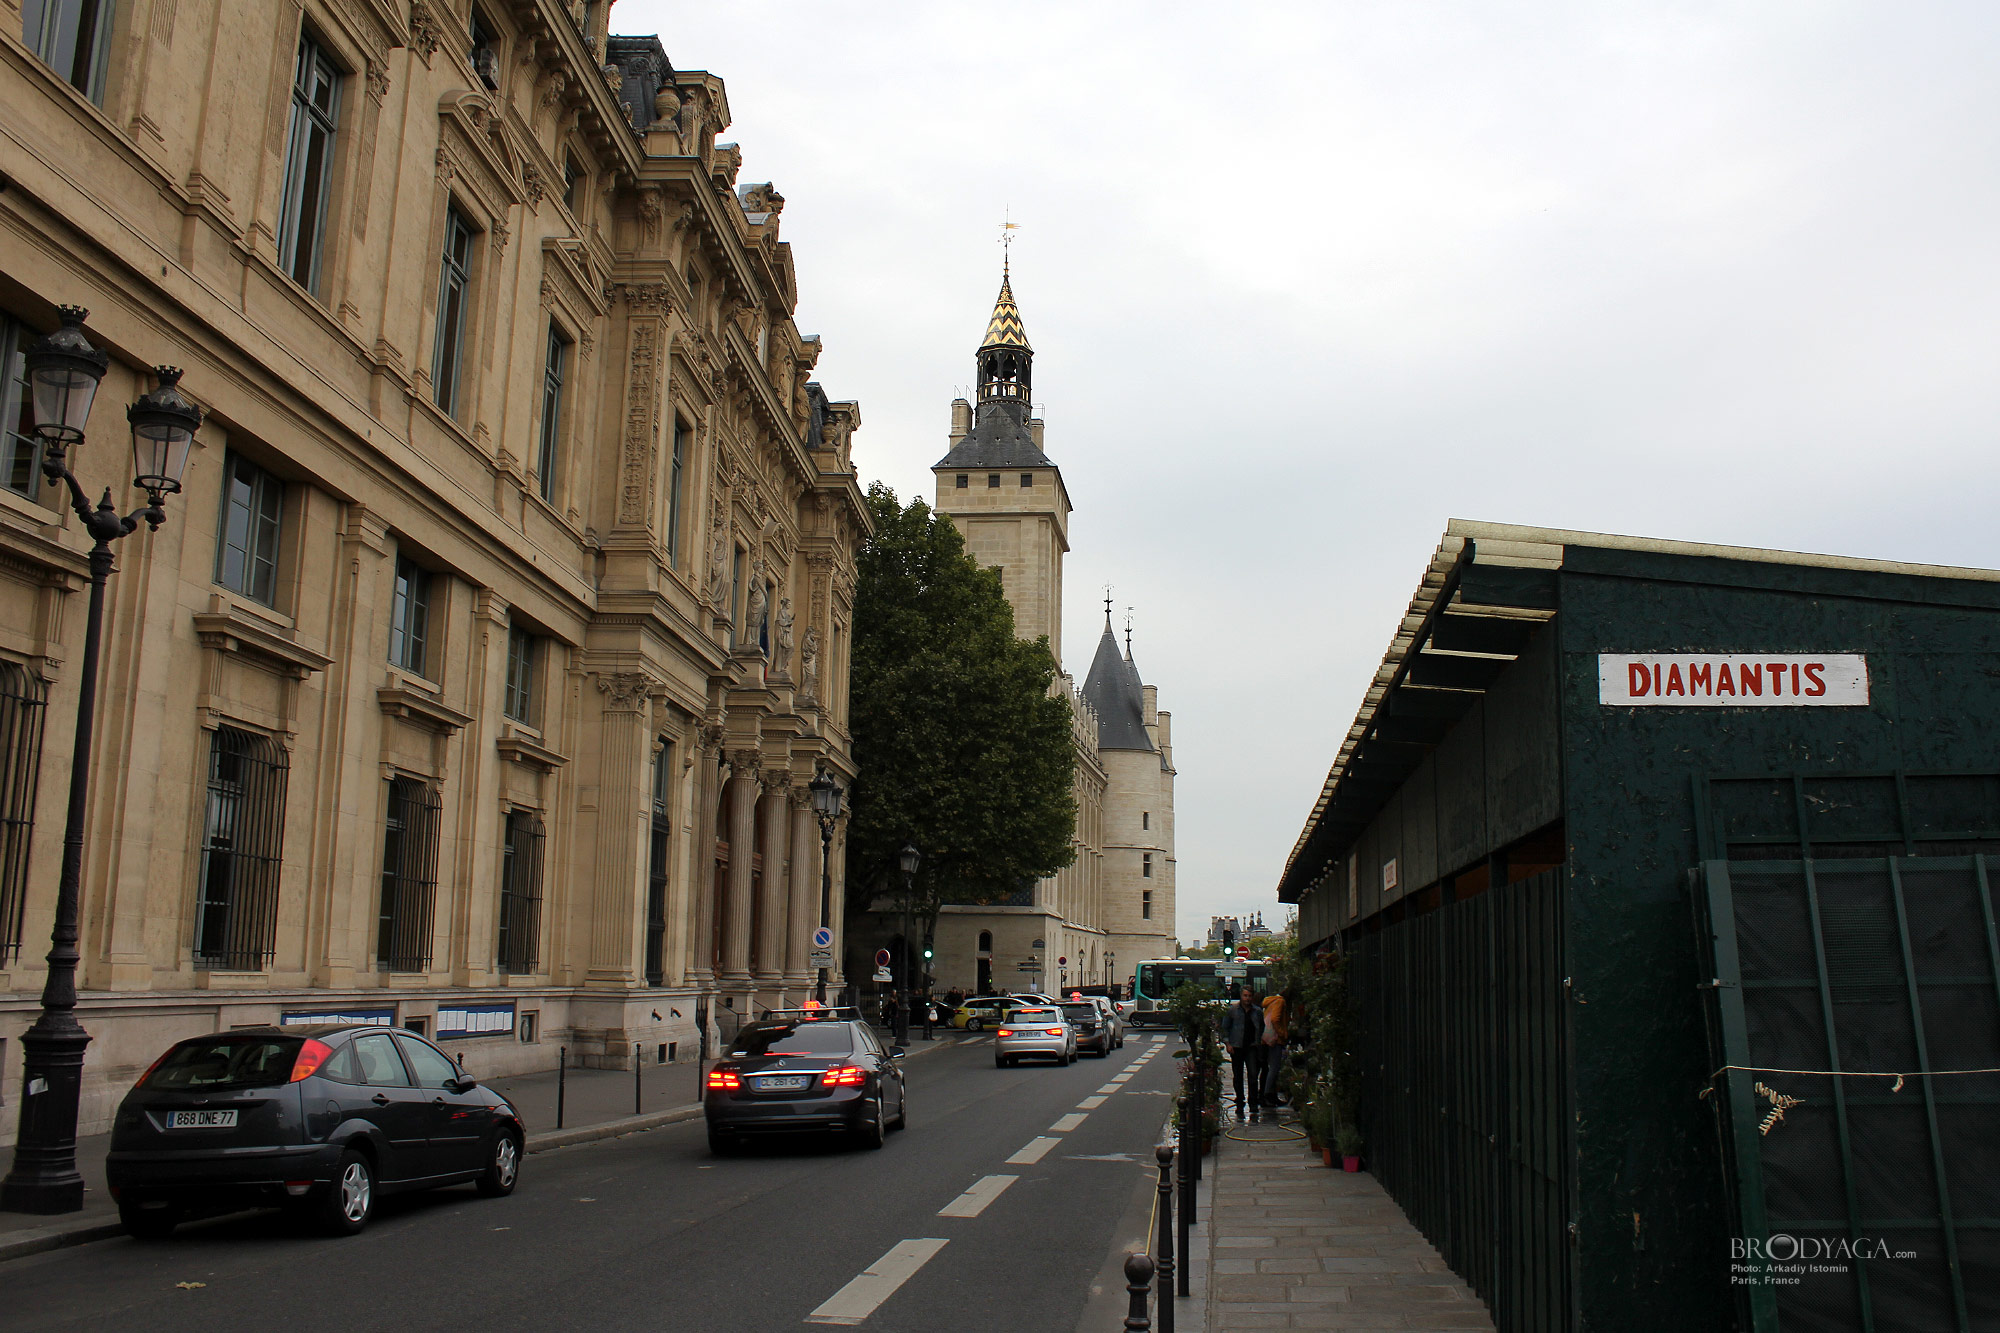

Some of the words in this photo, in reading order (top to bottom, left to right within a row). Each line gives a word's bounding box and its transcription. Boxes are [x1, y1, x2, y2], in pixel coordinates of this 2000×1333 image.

[1628, 662, 1827, 697] DIAMANTIS
[177, 1113, 196, 1125] 868
[198, 1112, 218, 1125] DNE
[220, 1111, 234, 1124] 77
